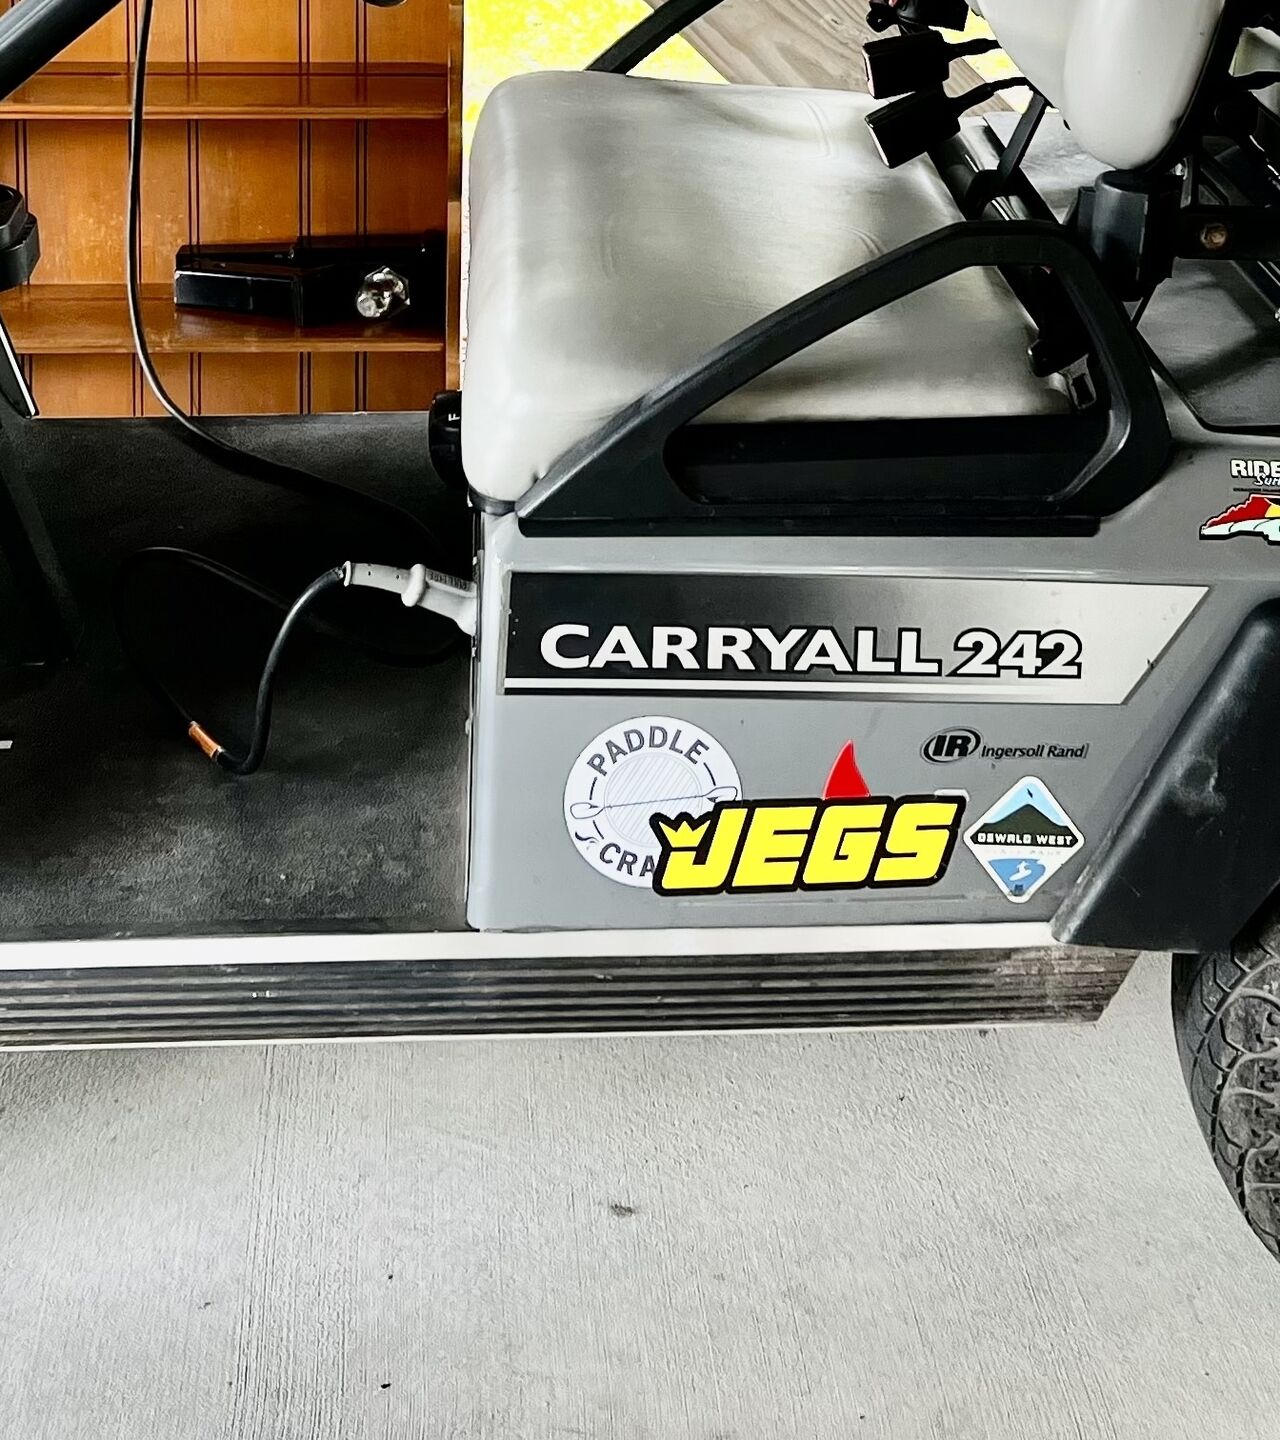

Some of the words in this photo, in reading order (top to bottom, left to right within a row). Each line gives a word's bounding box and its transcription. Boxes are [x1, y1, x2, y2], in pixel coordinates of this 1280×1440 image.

[540, 623, 941, 675] CARRYALL
[948, 627, 1082, 678] 242
[587, 725, 710, 776] PADDLE
[981, 744, 1046, 760] Ingersoll
[1047, 744, 1086, 759] Rand
[660, 802, 959, 890] JEGS
[977, 832, 1032, 845] OSWALD
[1036, 833, 1073, 847] WEST
